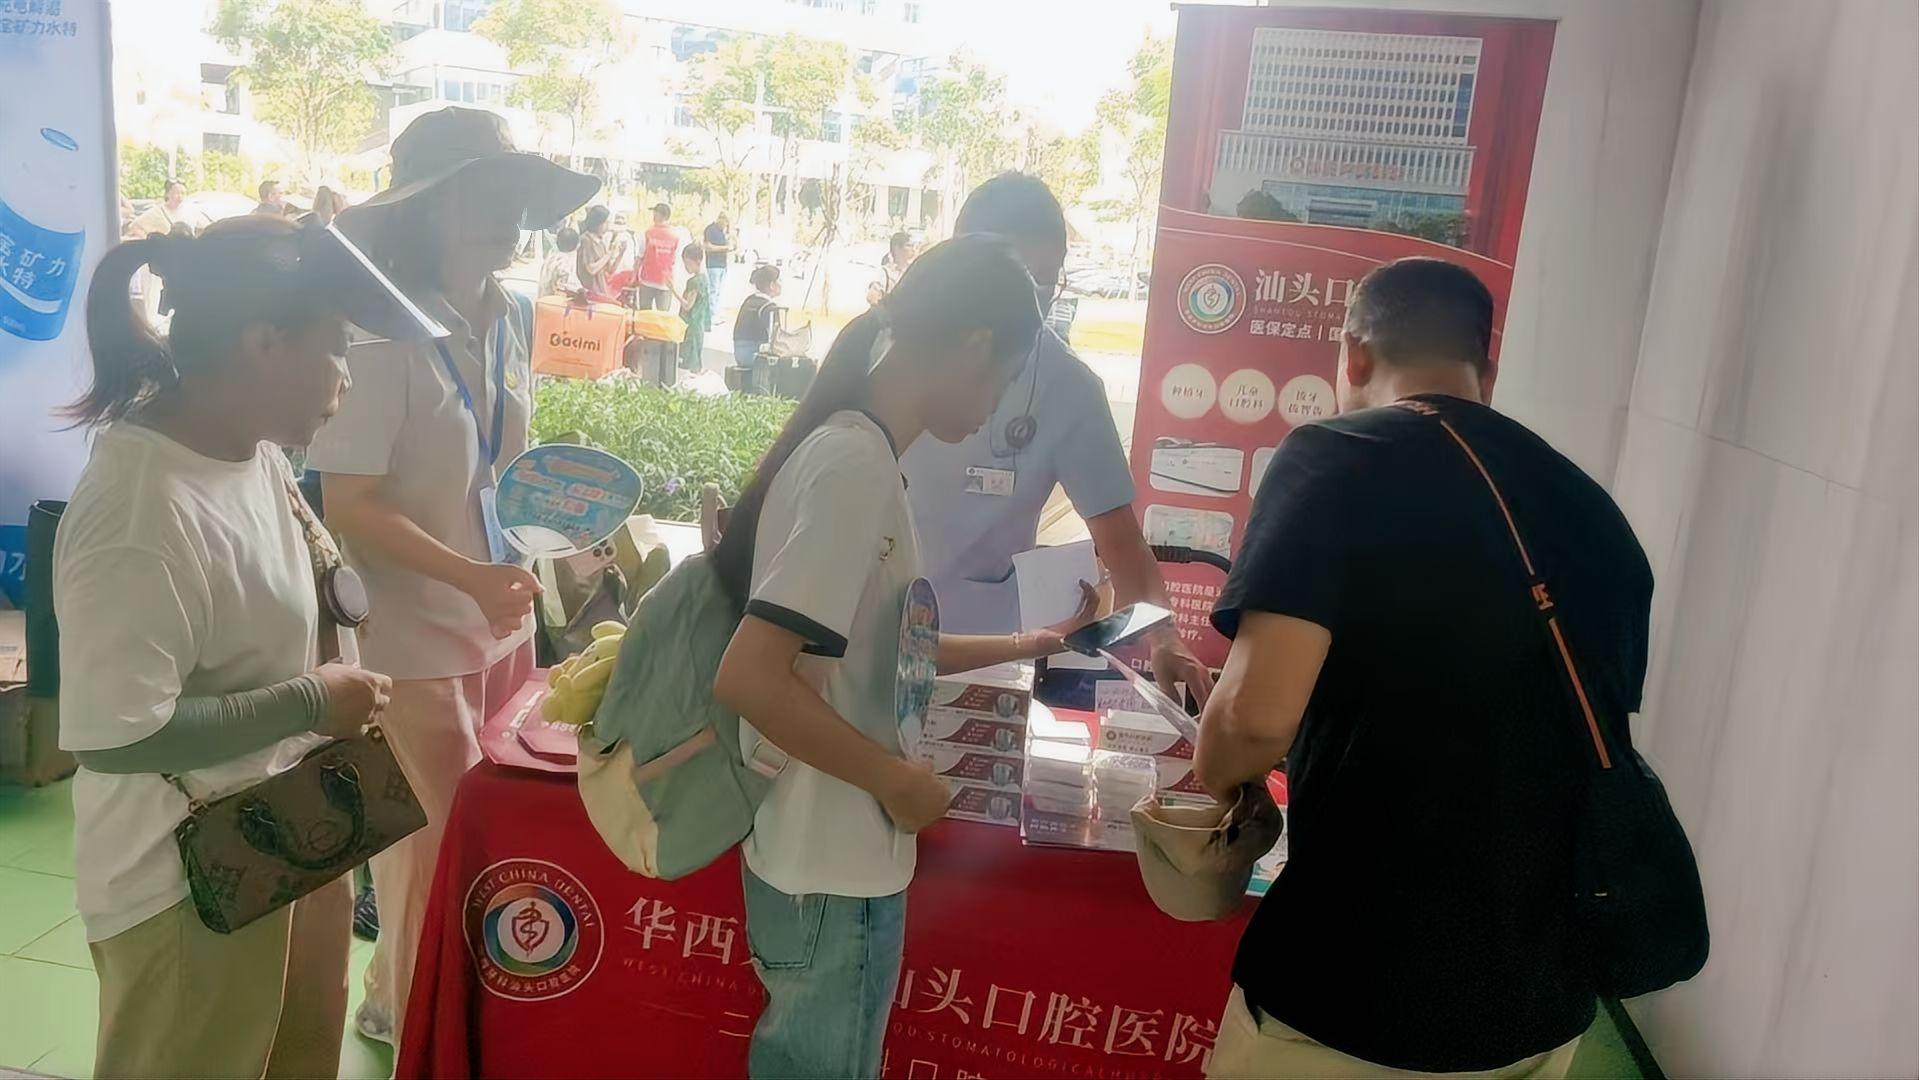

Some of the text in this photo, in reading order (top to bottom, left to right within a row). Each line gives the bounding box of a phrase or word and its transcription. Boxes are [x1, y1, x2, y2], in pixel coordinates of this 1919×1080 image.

[1250, 320, 1312, 339] 医保定点
[498, 869, 549, 883] CHINA
[892, 966, 1217, 1074] 头口腔医院
